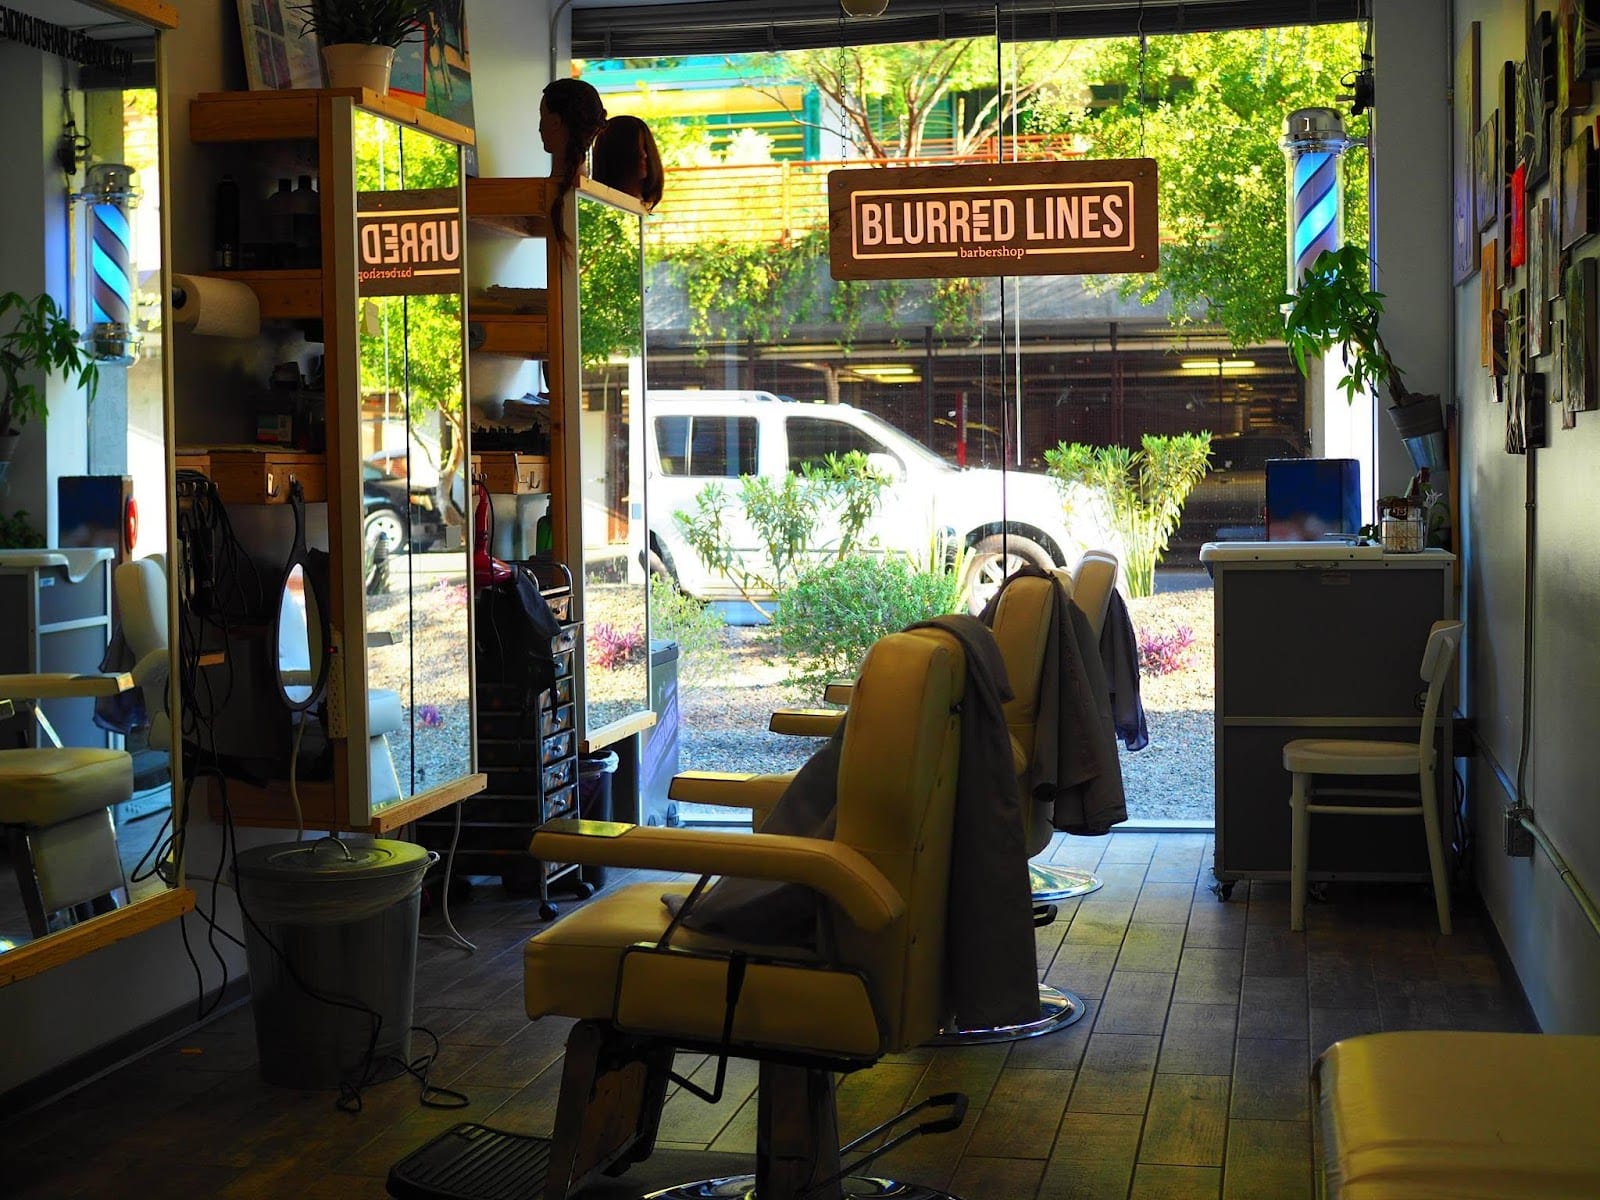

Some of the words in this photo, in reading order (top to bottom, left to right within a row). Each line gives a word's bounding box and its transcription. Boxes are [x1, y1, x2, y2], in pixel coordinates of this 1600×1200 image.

[861, 198, 1015, 246] BLURRED
[1025, 194, 1124, 241] LINES
[959, 244, 1025, 260] barbershop
